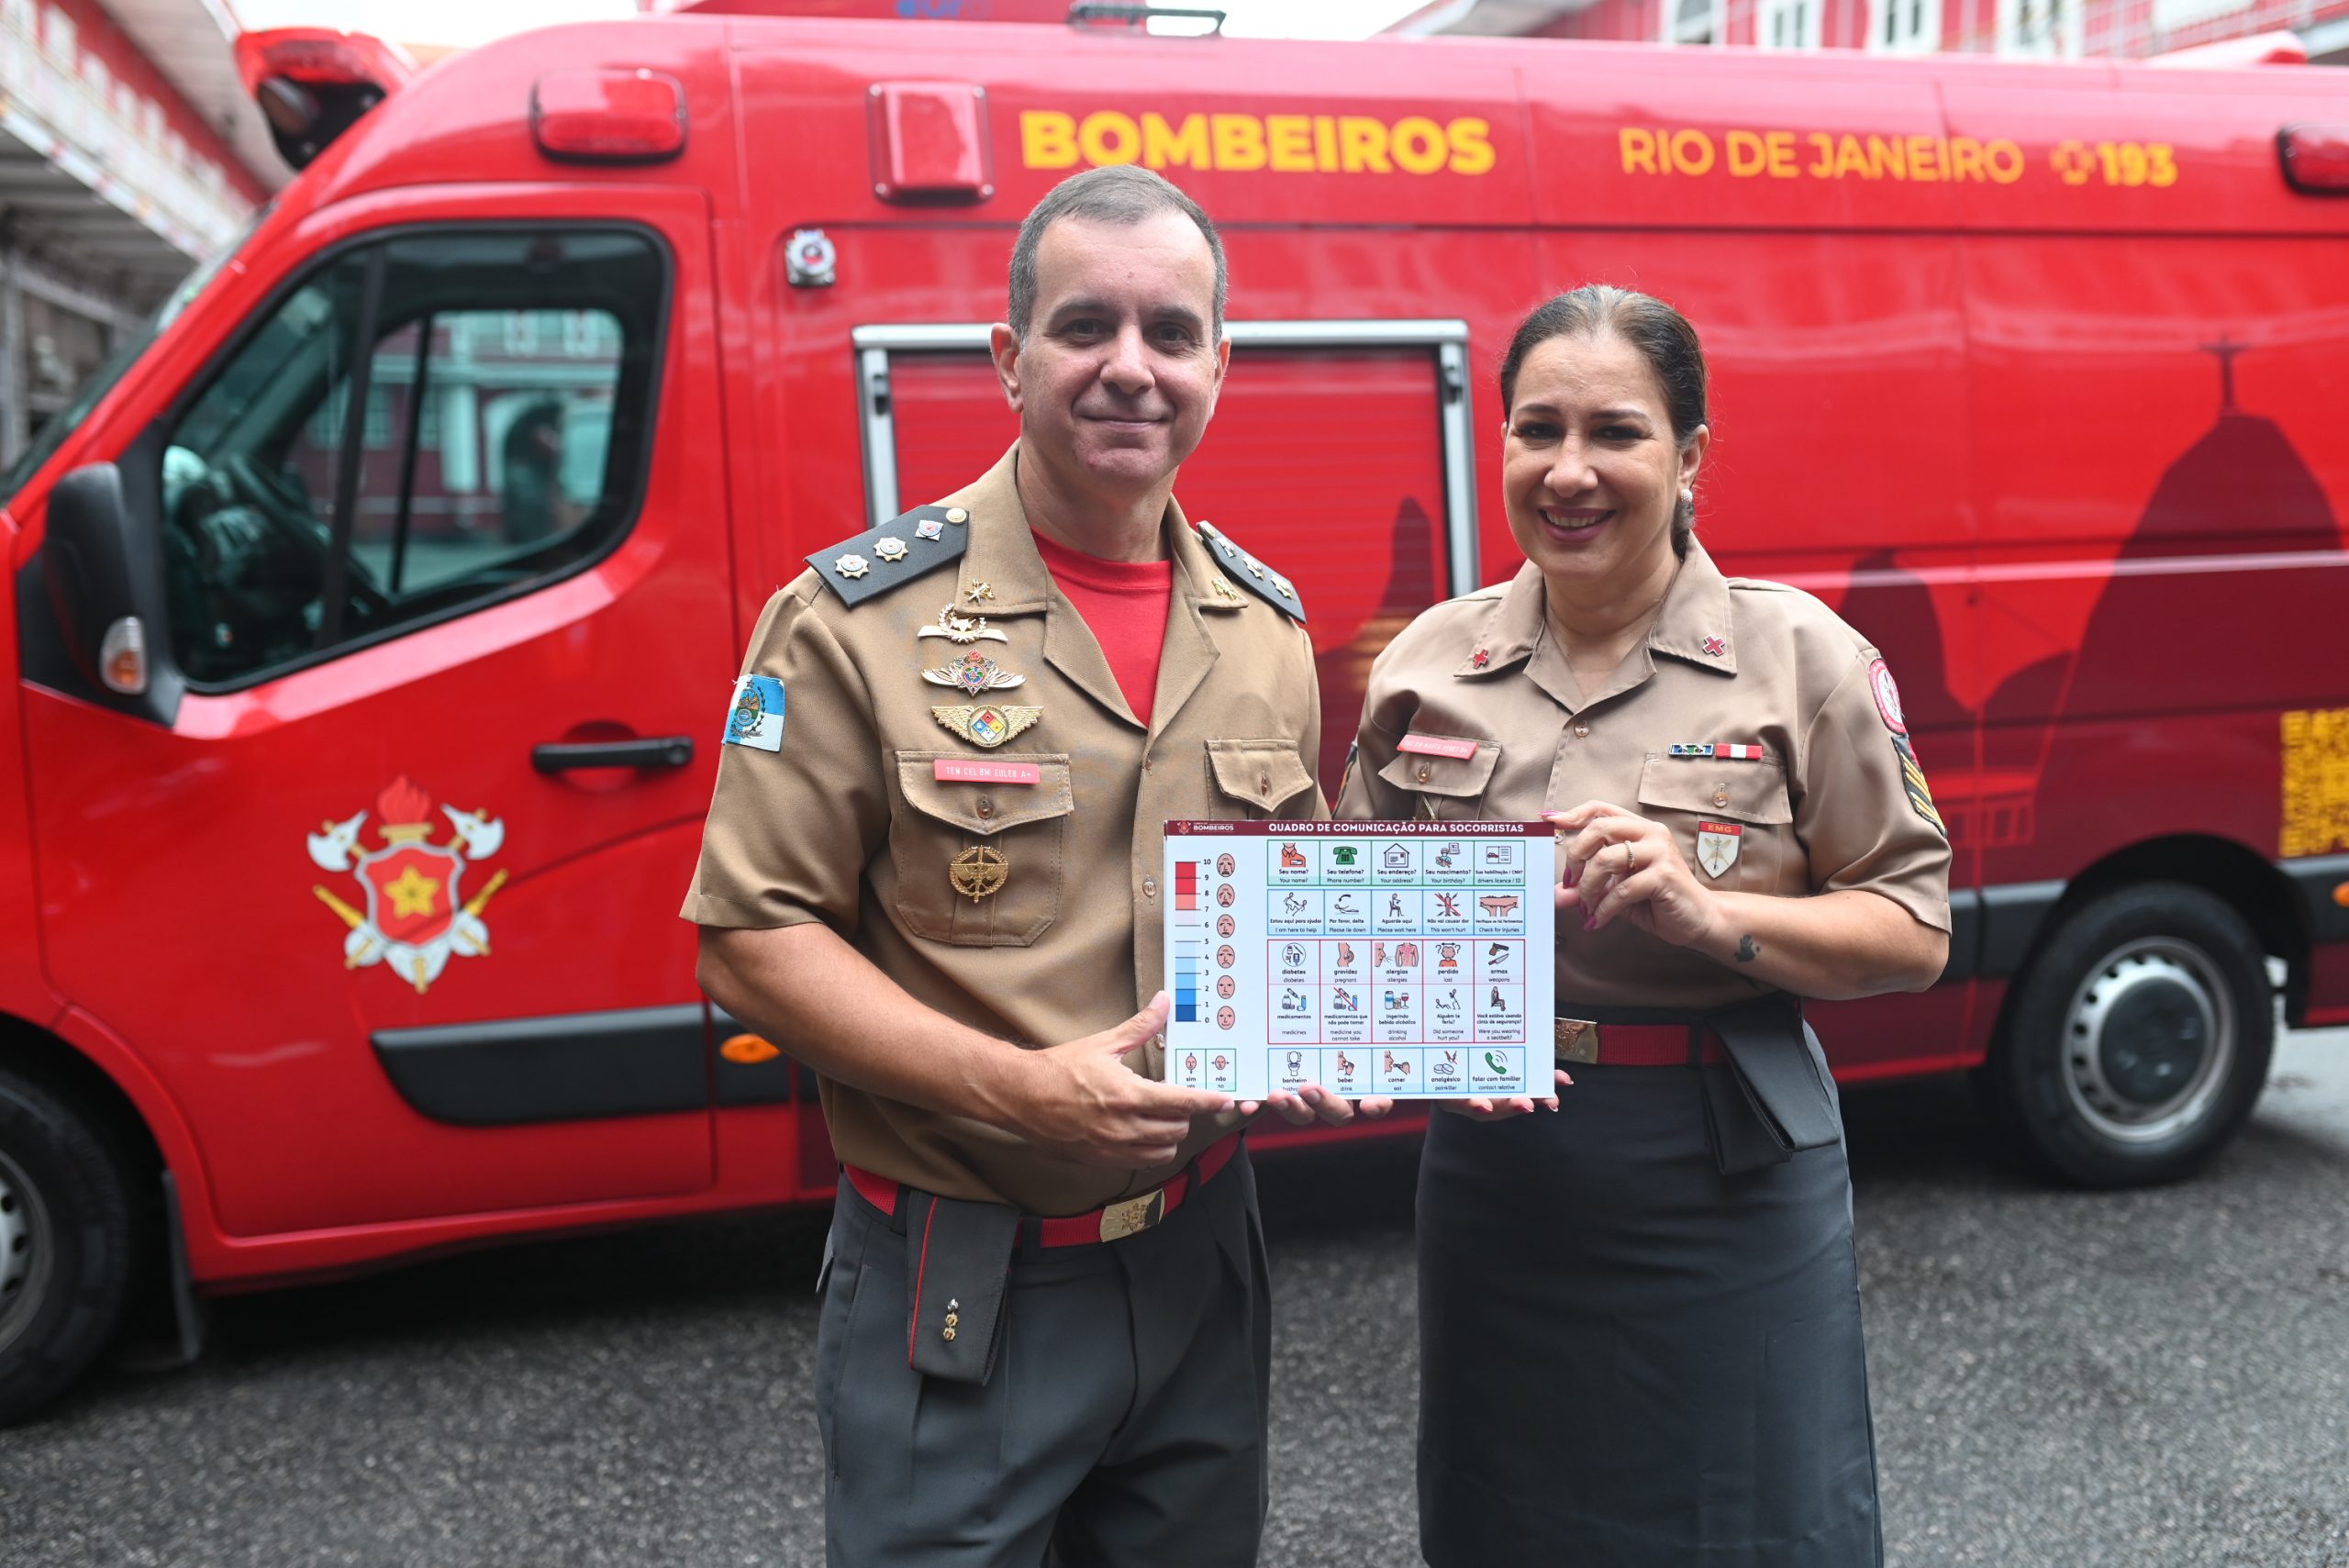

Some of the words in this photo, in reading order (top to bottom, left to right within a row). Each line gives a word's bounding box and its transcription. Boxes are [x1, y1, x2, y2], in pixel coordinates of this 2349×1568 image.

[1019, 110, 1496, 175] BOMBEIROS
[1619, 128, 1714, 176] RIO
[1727, 130, 1800, 178] DE
[1808, 132, 2025, 183] JANEIRO
[2099, 141, 2177, 187] 193
[947, 767, 960, 775] TEN
[964, 768, 976, 776] CEL
[994, 769, 1016, 778] EULER
[1269, 824, 1314, 832] QUADRO
[1333, 822, 1415, 834] COMUNICAÇÃO
[1708, 825, 1732, 833] EMG
